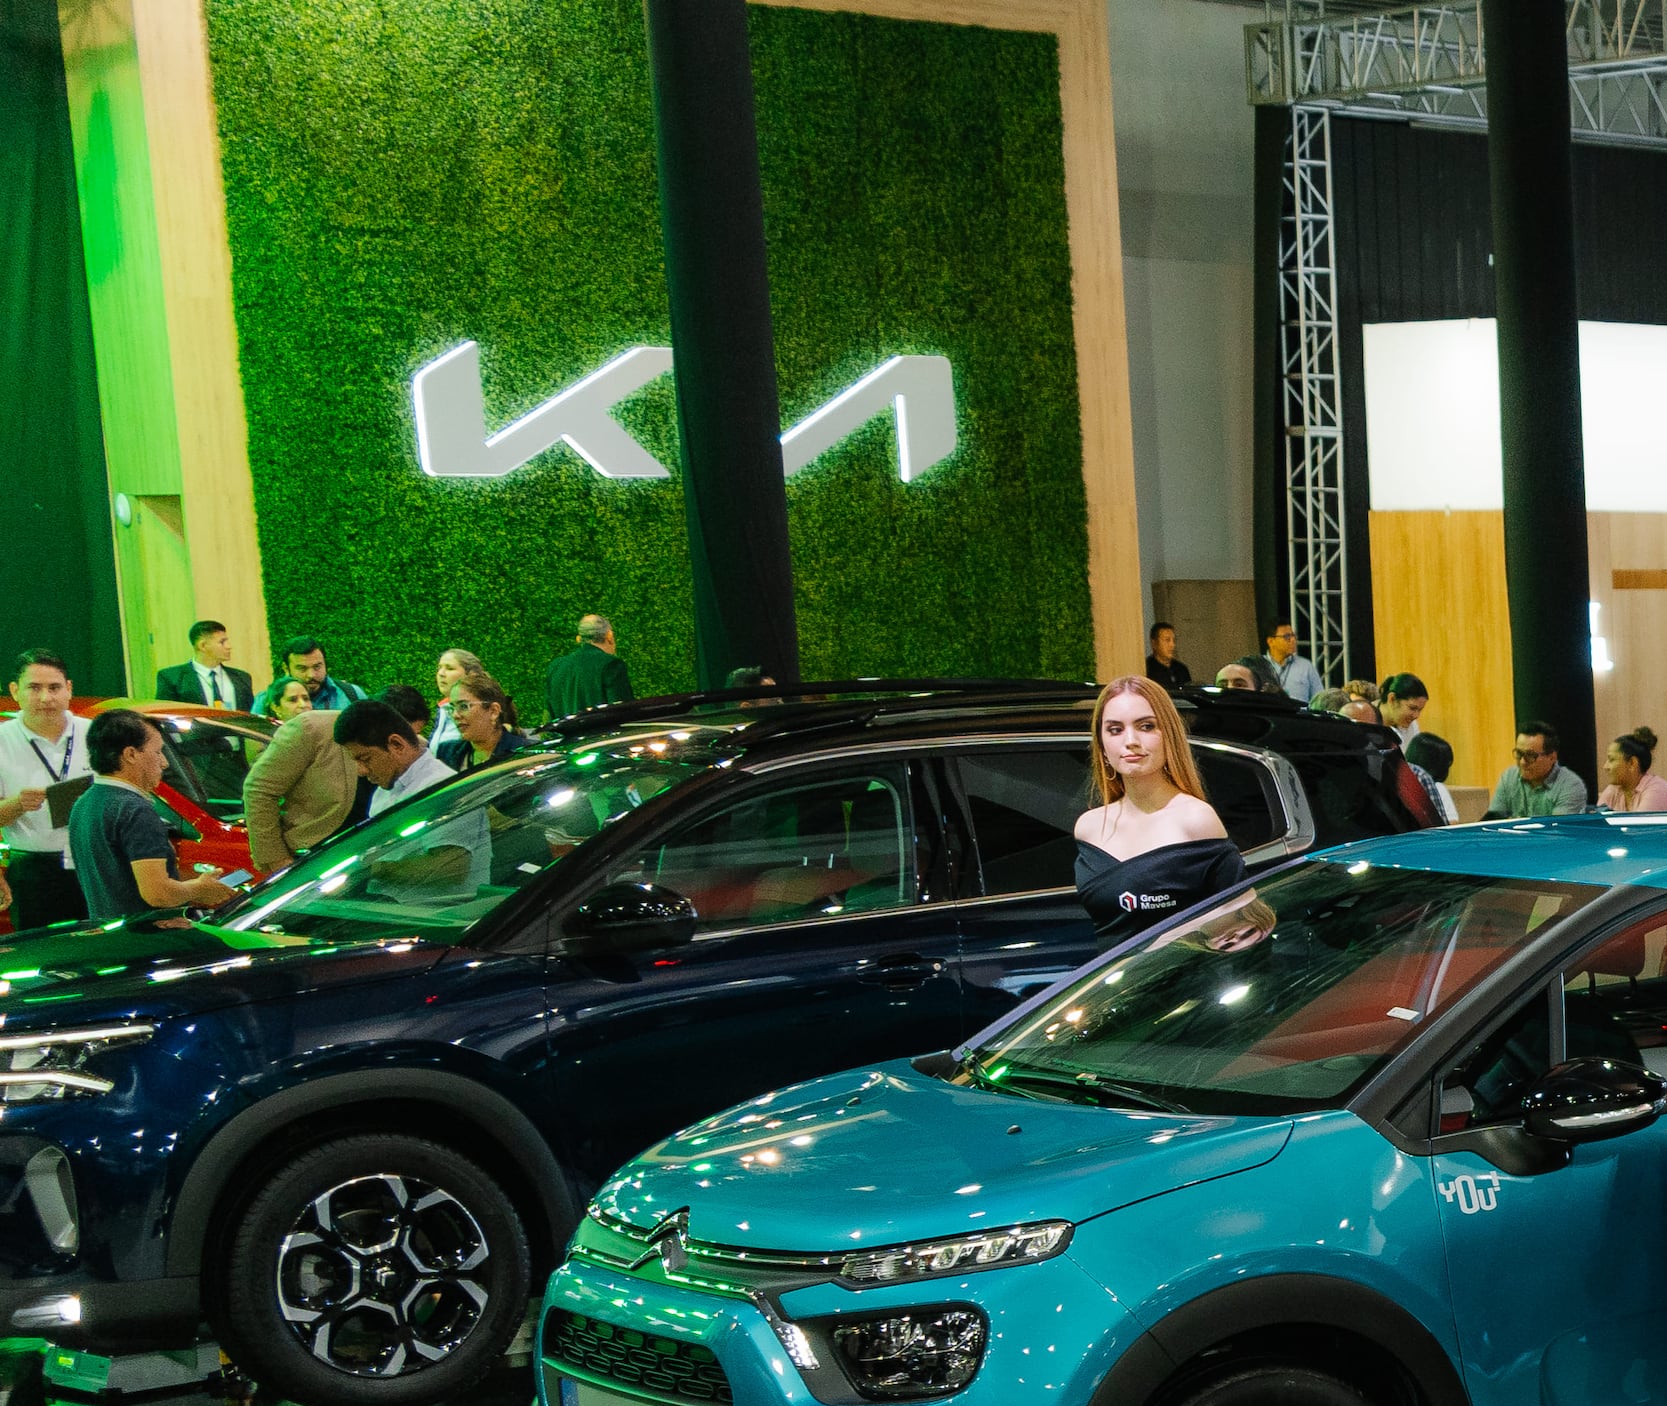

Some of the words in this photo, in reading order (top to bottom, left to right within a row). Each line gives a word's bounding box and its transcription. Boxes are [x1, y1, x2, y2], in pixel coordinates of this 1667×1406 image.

[413, 340, 957, 483] KA
[1140, 894, 1170, 903] Grupo
[1140, 900, 1177, 910] Mavesa
[1438, 1170, 1501, 1215] YOU!
